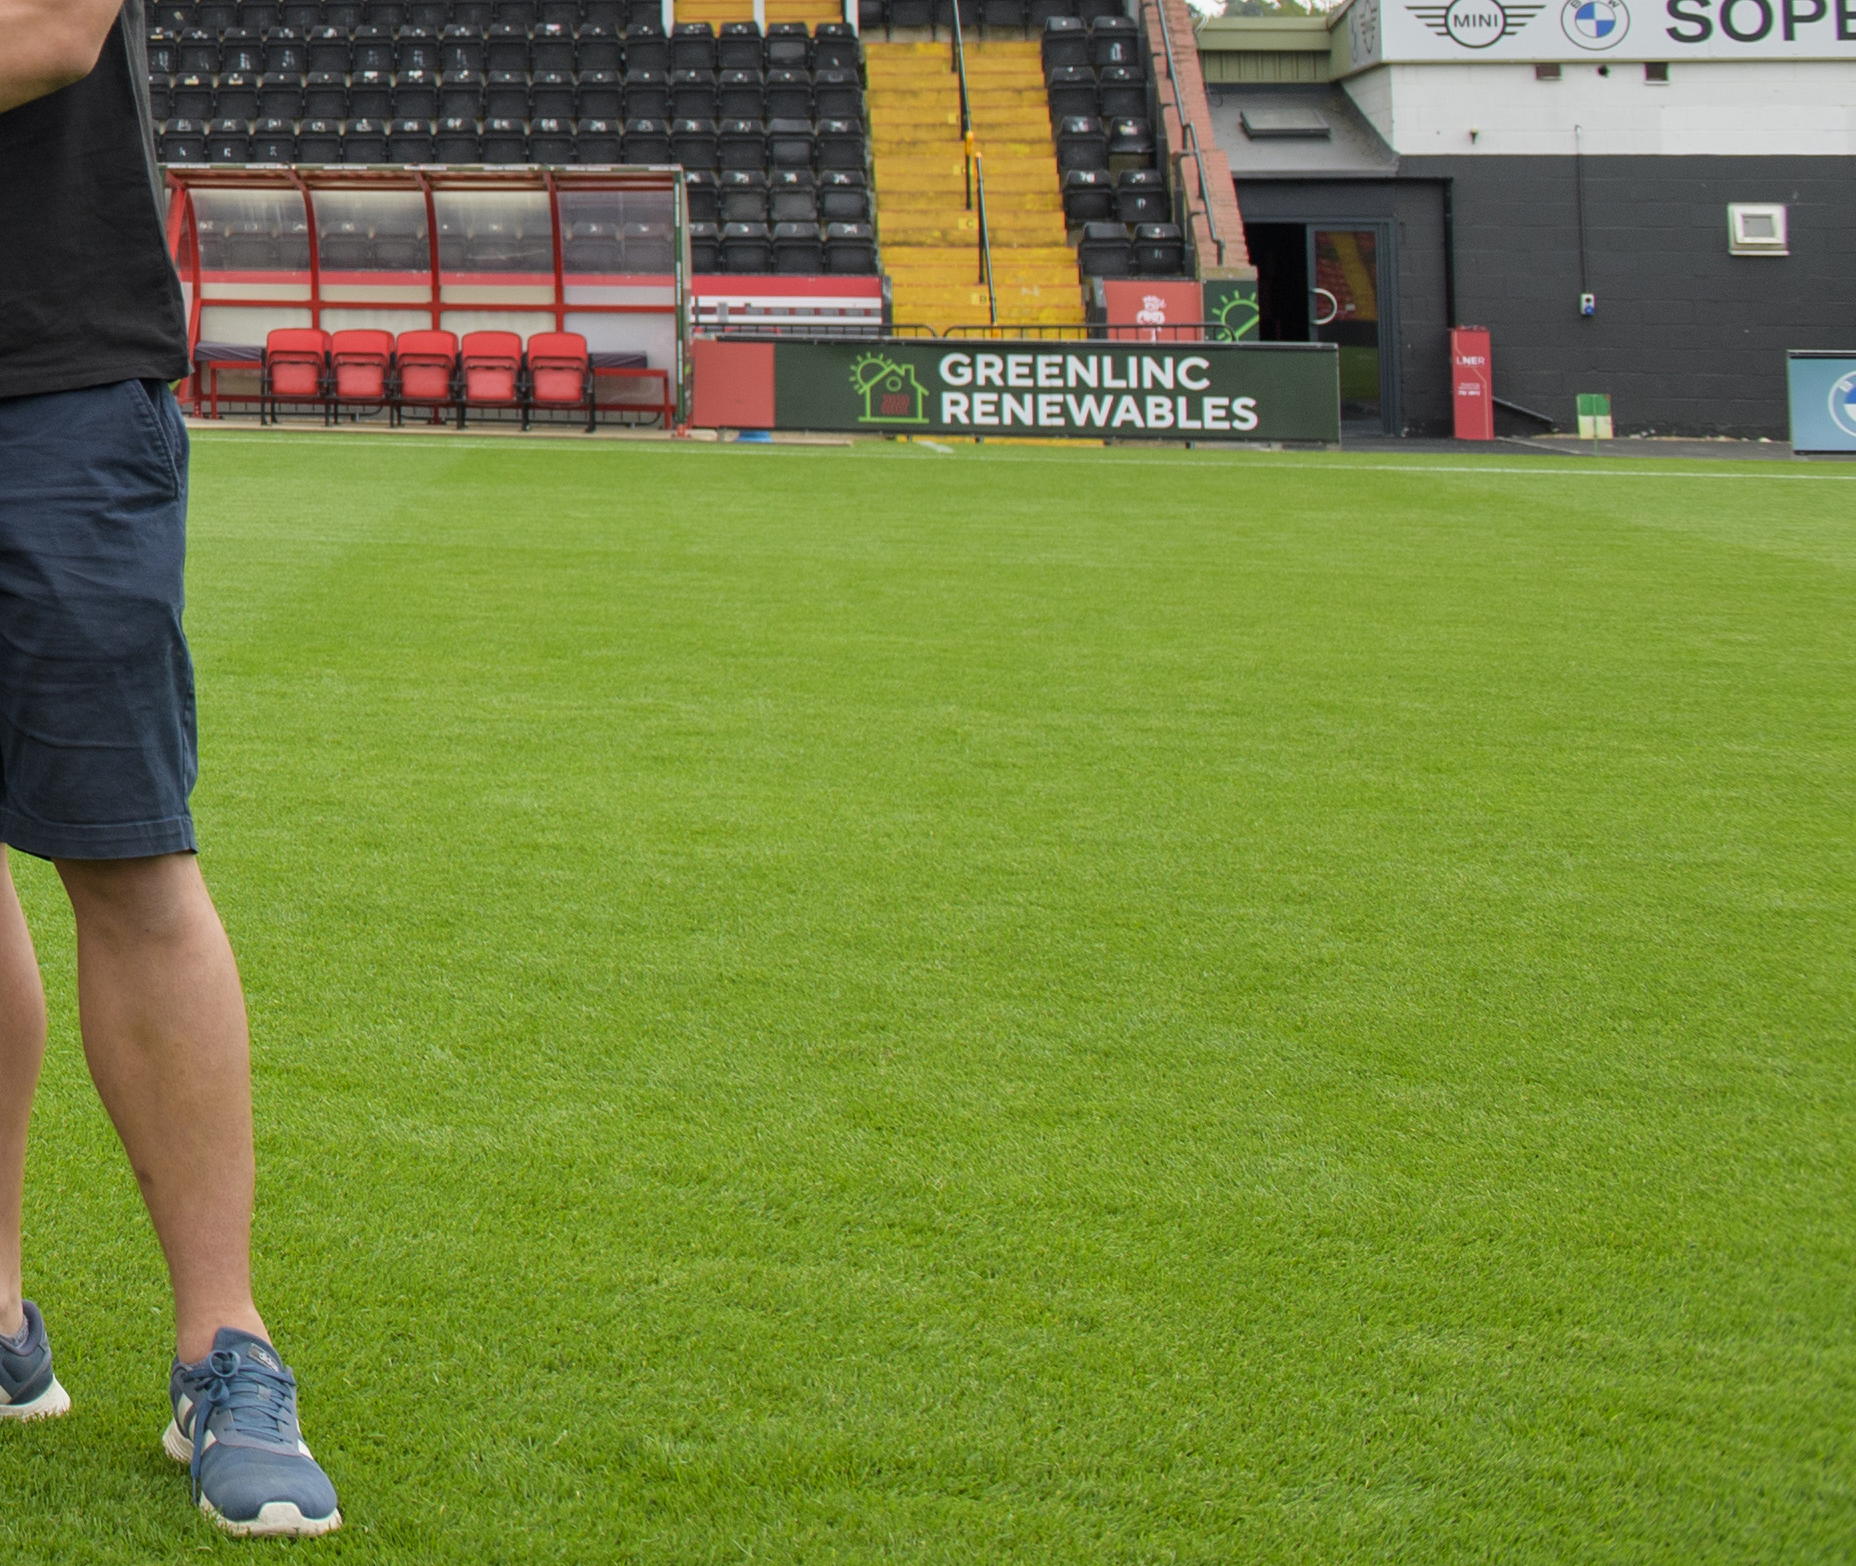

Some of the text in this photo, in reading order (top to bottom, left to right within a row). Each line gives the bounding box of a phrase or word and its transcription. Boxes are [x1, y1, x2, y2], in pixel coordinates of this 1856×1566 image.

[1453, 14, 1499, 29] MINI
[939, 352, 1211, 391] GREENLINC
[1456, 356, 1485, 366] LNER
[941, 391, 1259, 431] RENEWABLES
